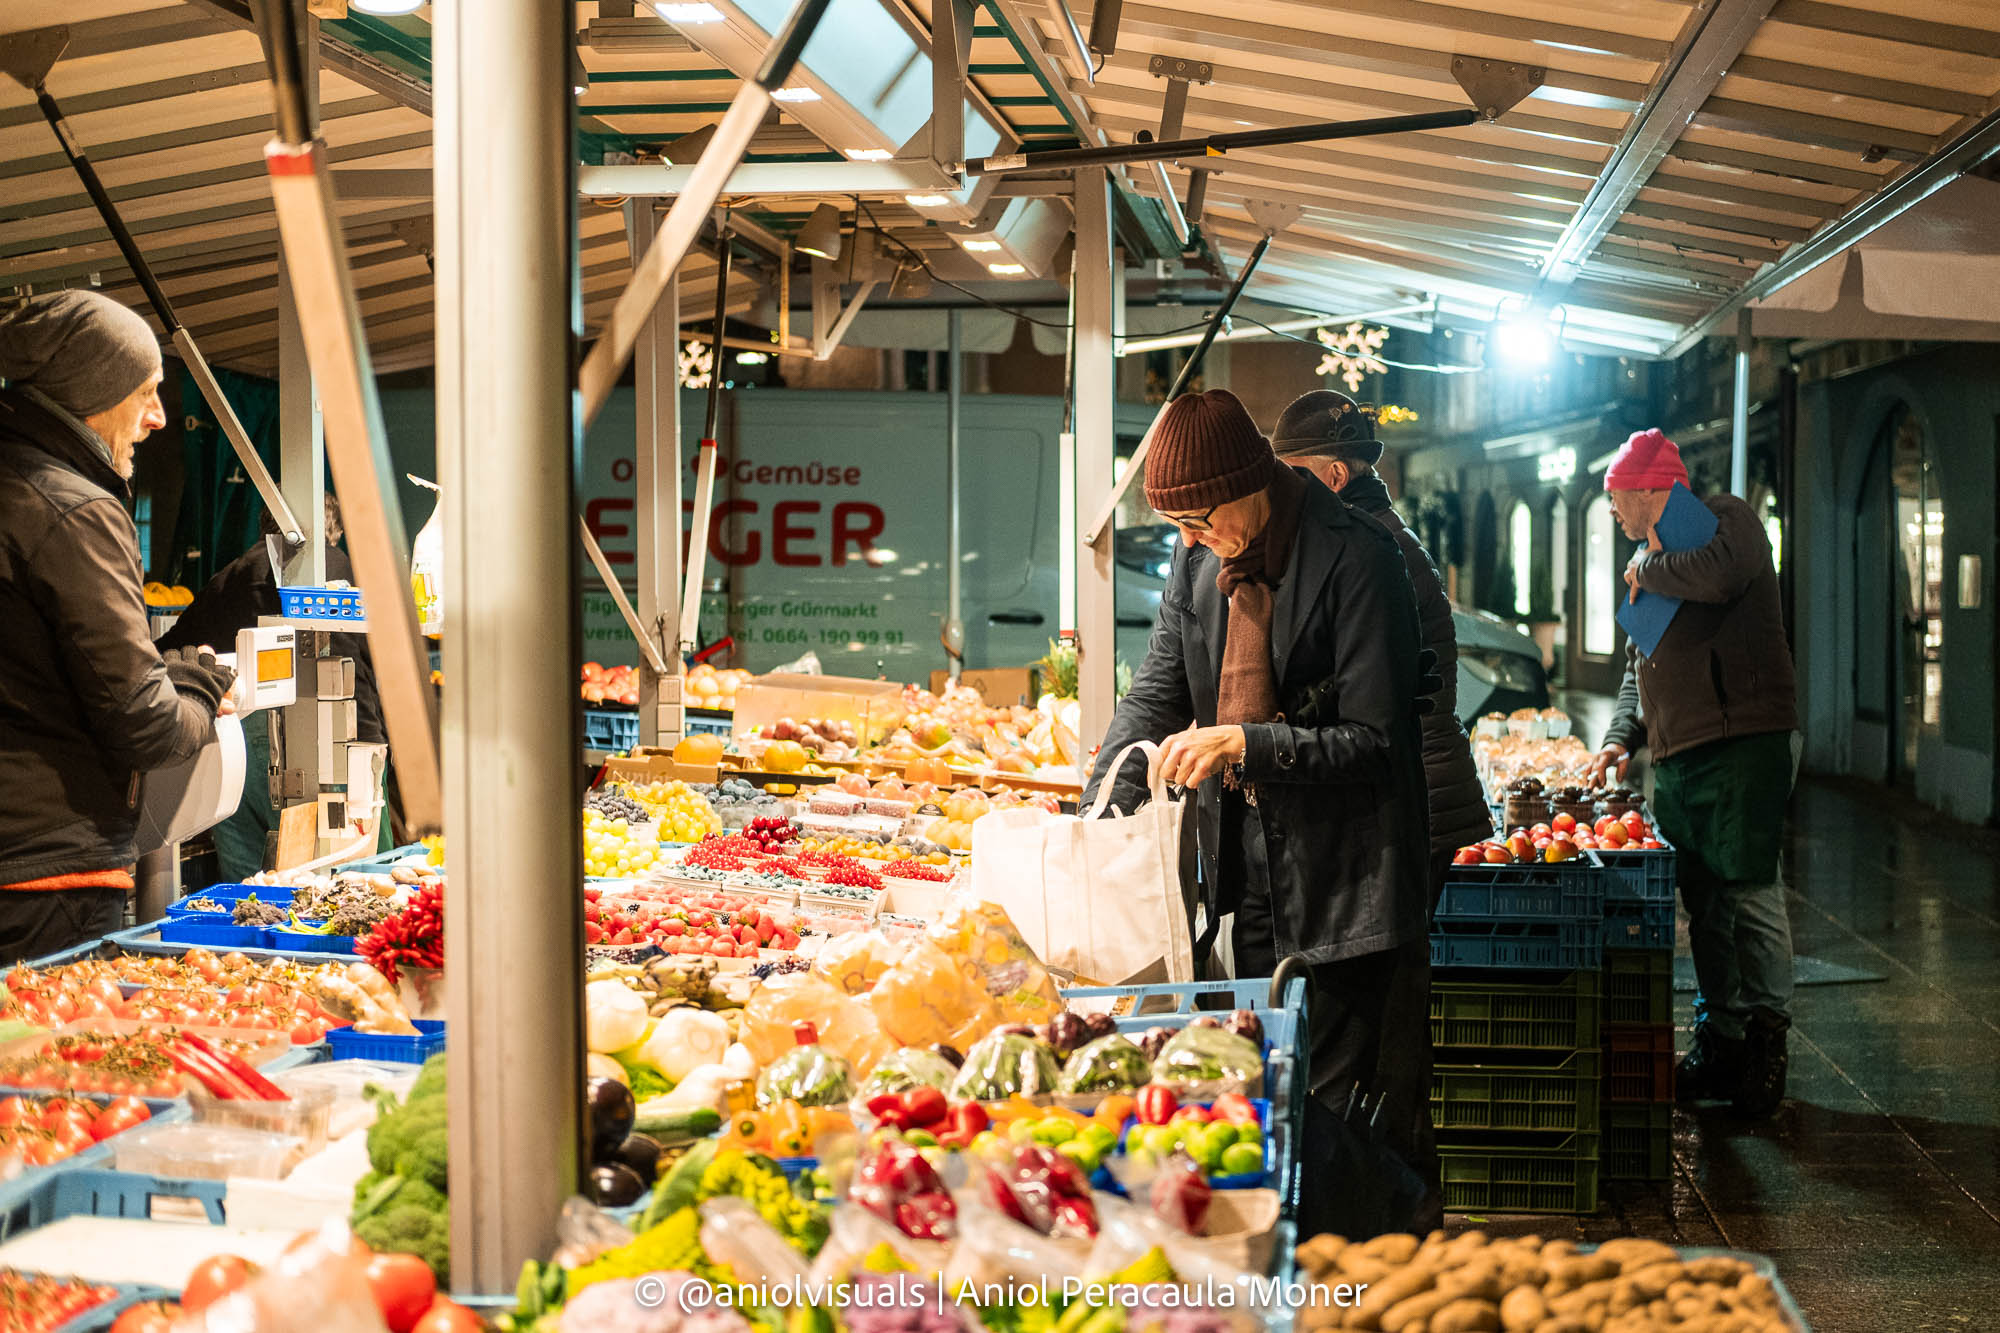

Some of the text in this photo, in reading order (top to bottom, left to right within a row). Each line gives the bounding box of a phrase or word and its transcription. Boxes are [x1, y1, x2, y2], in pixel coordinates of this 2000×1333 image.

[735, 461, 861, 486] Gemüse
[585, 497, 885, 568] EGER
[781, 601, 877, 618] Grünmarkt
[763, 628, 808, 644] 0664
